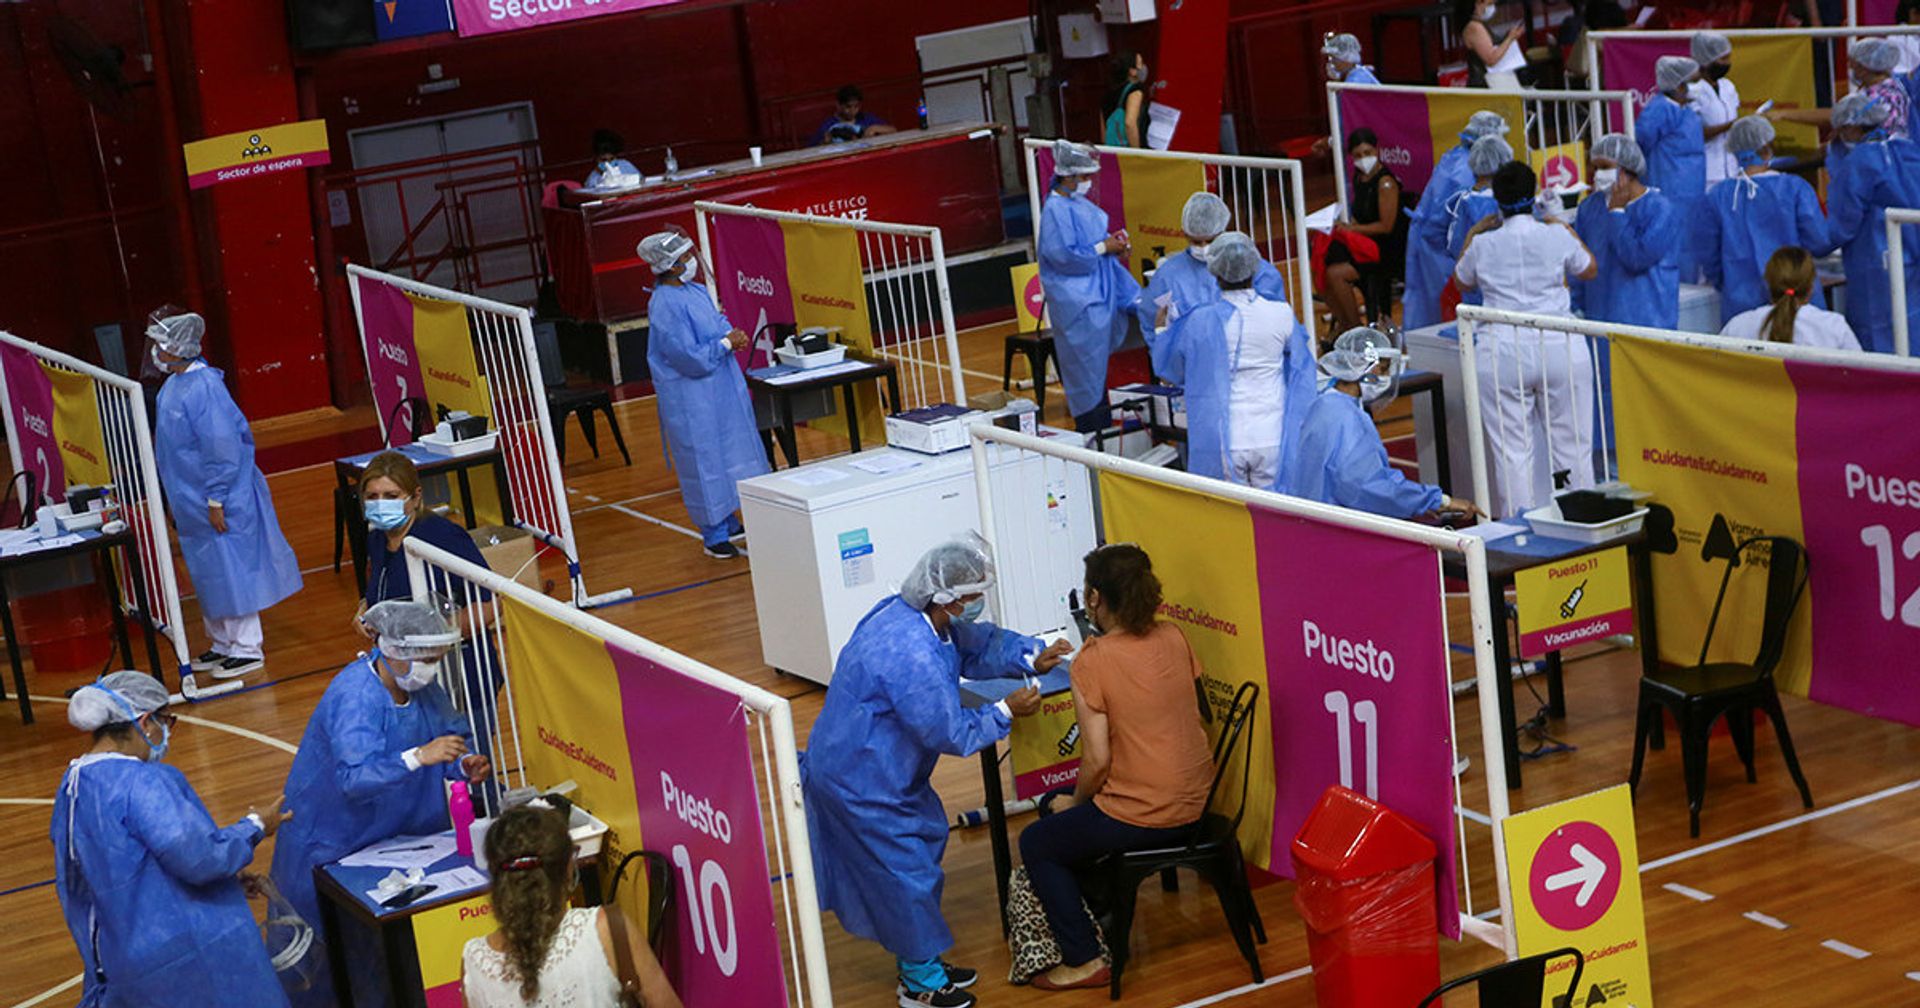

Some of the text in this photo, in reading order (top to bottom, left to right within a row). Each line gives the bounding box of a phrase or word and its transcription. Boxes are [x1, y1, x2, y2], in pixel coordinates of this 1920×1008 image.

[217, 158, 303, 181] Sector de espera
[737, 270, 774, 298] Puesto
[1548, 558, 1599, 580] Puesto 11
[1303, 619, 1395, 682] Puesto
[1544, 621, 1610, 646] Vacunación
[1324, 690, 1379, 802] 11
[660, 770, 731, 844] Puesto
[672, 844, 738, 977] 10
